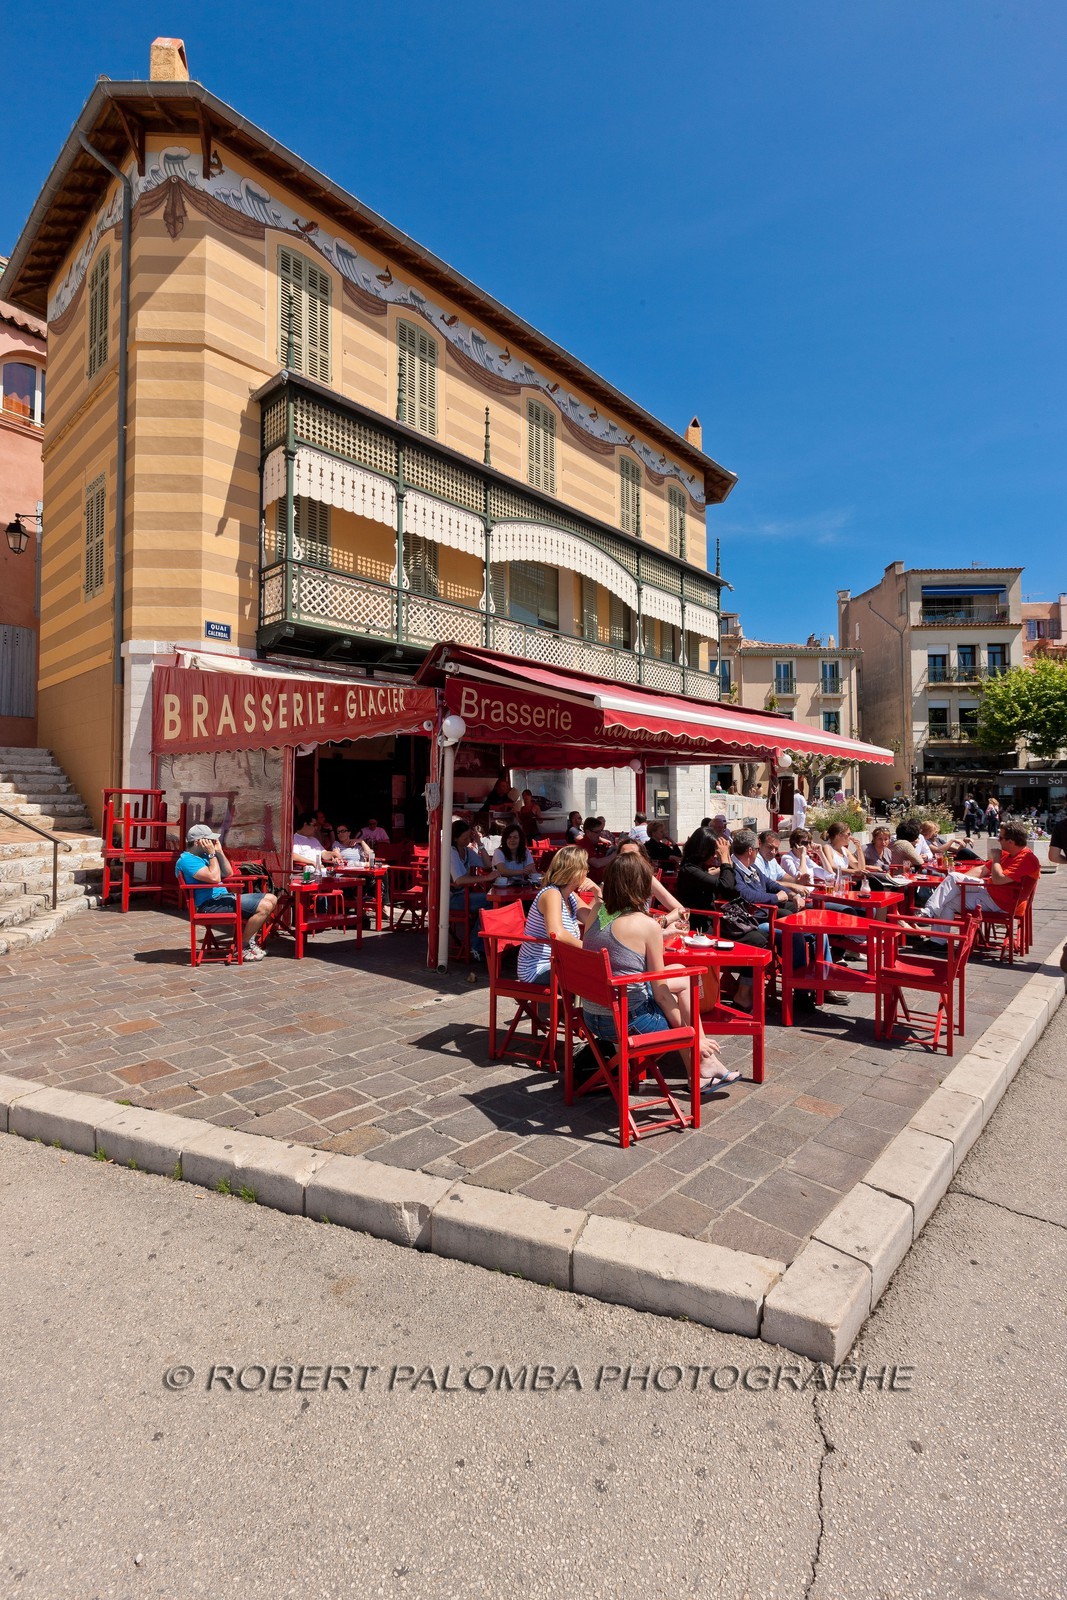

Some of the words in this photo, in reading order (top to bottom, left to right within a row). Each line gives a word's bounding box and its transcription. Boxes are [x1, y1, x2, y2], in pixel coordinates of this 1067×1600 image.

[210, 623, 227, 631] QUAI
[207, 630, 229, 638] CALENDAL
[460, 686, 572, 731] Brasserie
[163, 692, 325, 740] BRASSERIE
[346, 688, 406, 719] GLACIER
[1029, 777, 1039, 785] El
[1047, 777, 1063, 785] Sol
